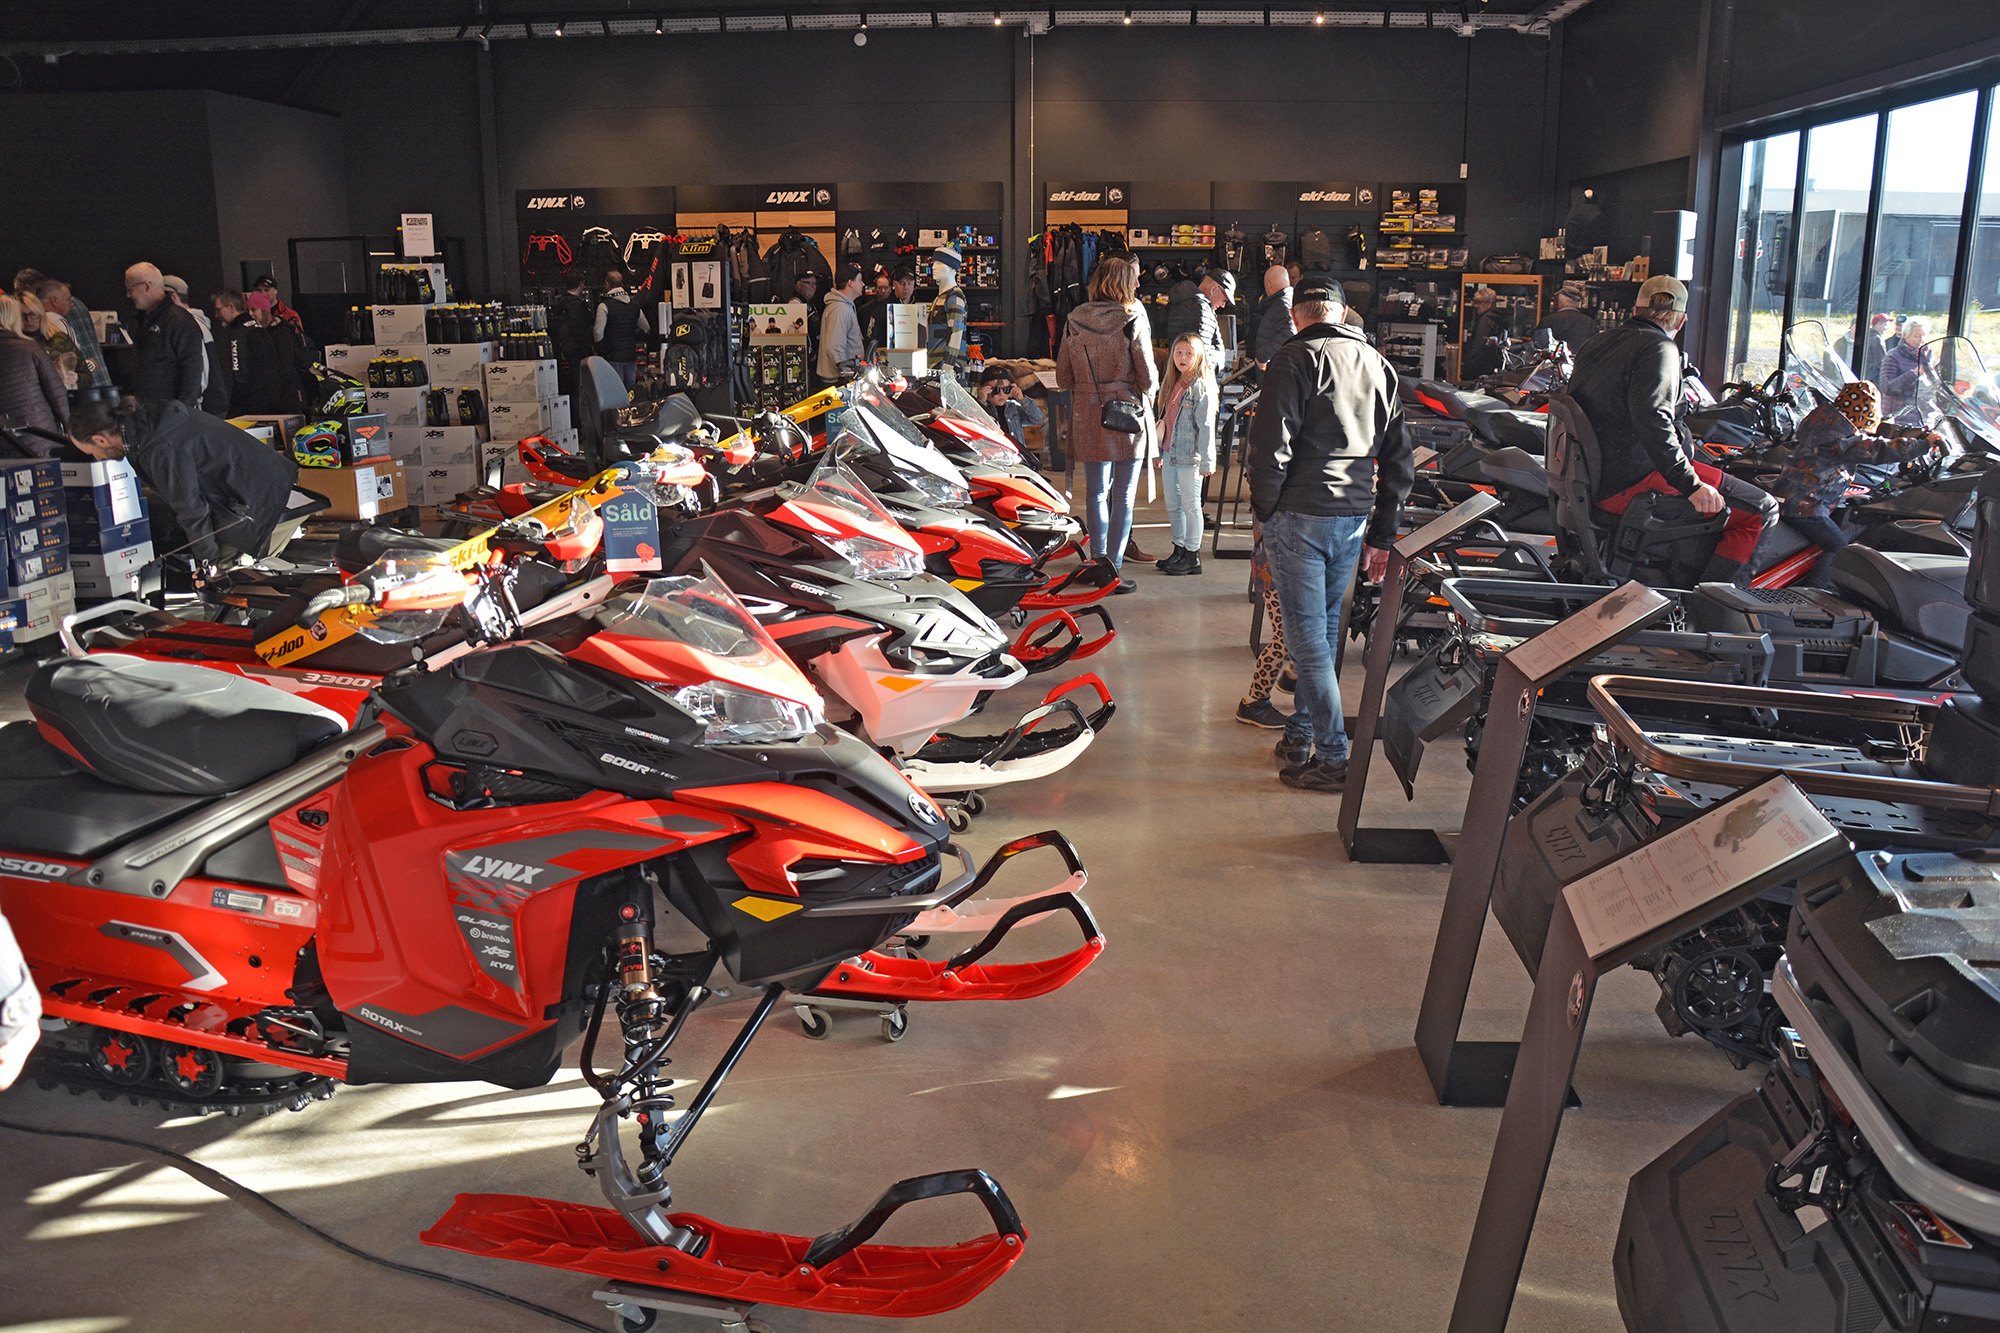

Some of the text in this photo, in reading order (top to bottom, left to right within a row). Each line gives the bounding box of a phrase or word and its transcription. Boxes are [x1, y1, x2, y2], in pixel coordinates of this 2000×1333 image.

[766, 191, 811, 204] LYNX
[1049, 191, 1101, 202] ski-doo
[1299, 191, 1351, 202] ski-doo
[527, 197, 568, 209] LYNX
[376, 308, 395, 317] XPS
[231, 340, 239, 371] ROTAX
[329, 349, 348, 357] XPS
[380, 348, 399, 356] XPS
[432, 347, 451, 355] XPS
[488, 366, 508, 374] XPS
[370, 391, 390, 399] XPS
[491, 405, 511, 413] XPS
[424, 430, 445, 438] XPS
[428, 470, 448, 478] XPS
[605, 502, 652, 523] Såld
[302, 672, 371, 687] 3300
[600, 752, 651, 775] 600R
[0, 857, 67, 877] 500
[462, 855, 544, 885] LYNX
[457, 915, 511, 931] BLADE
[481, 931, 510, 944] brembo
[481, 945, 511, 958] XPS
[360, 1007, 405, 1033] ROTAX
[1704, 1208, 1779, 1302] LYNX
